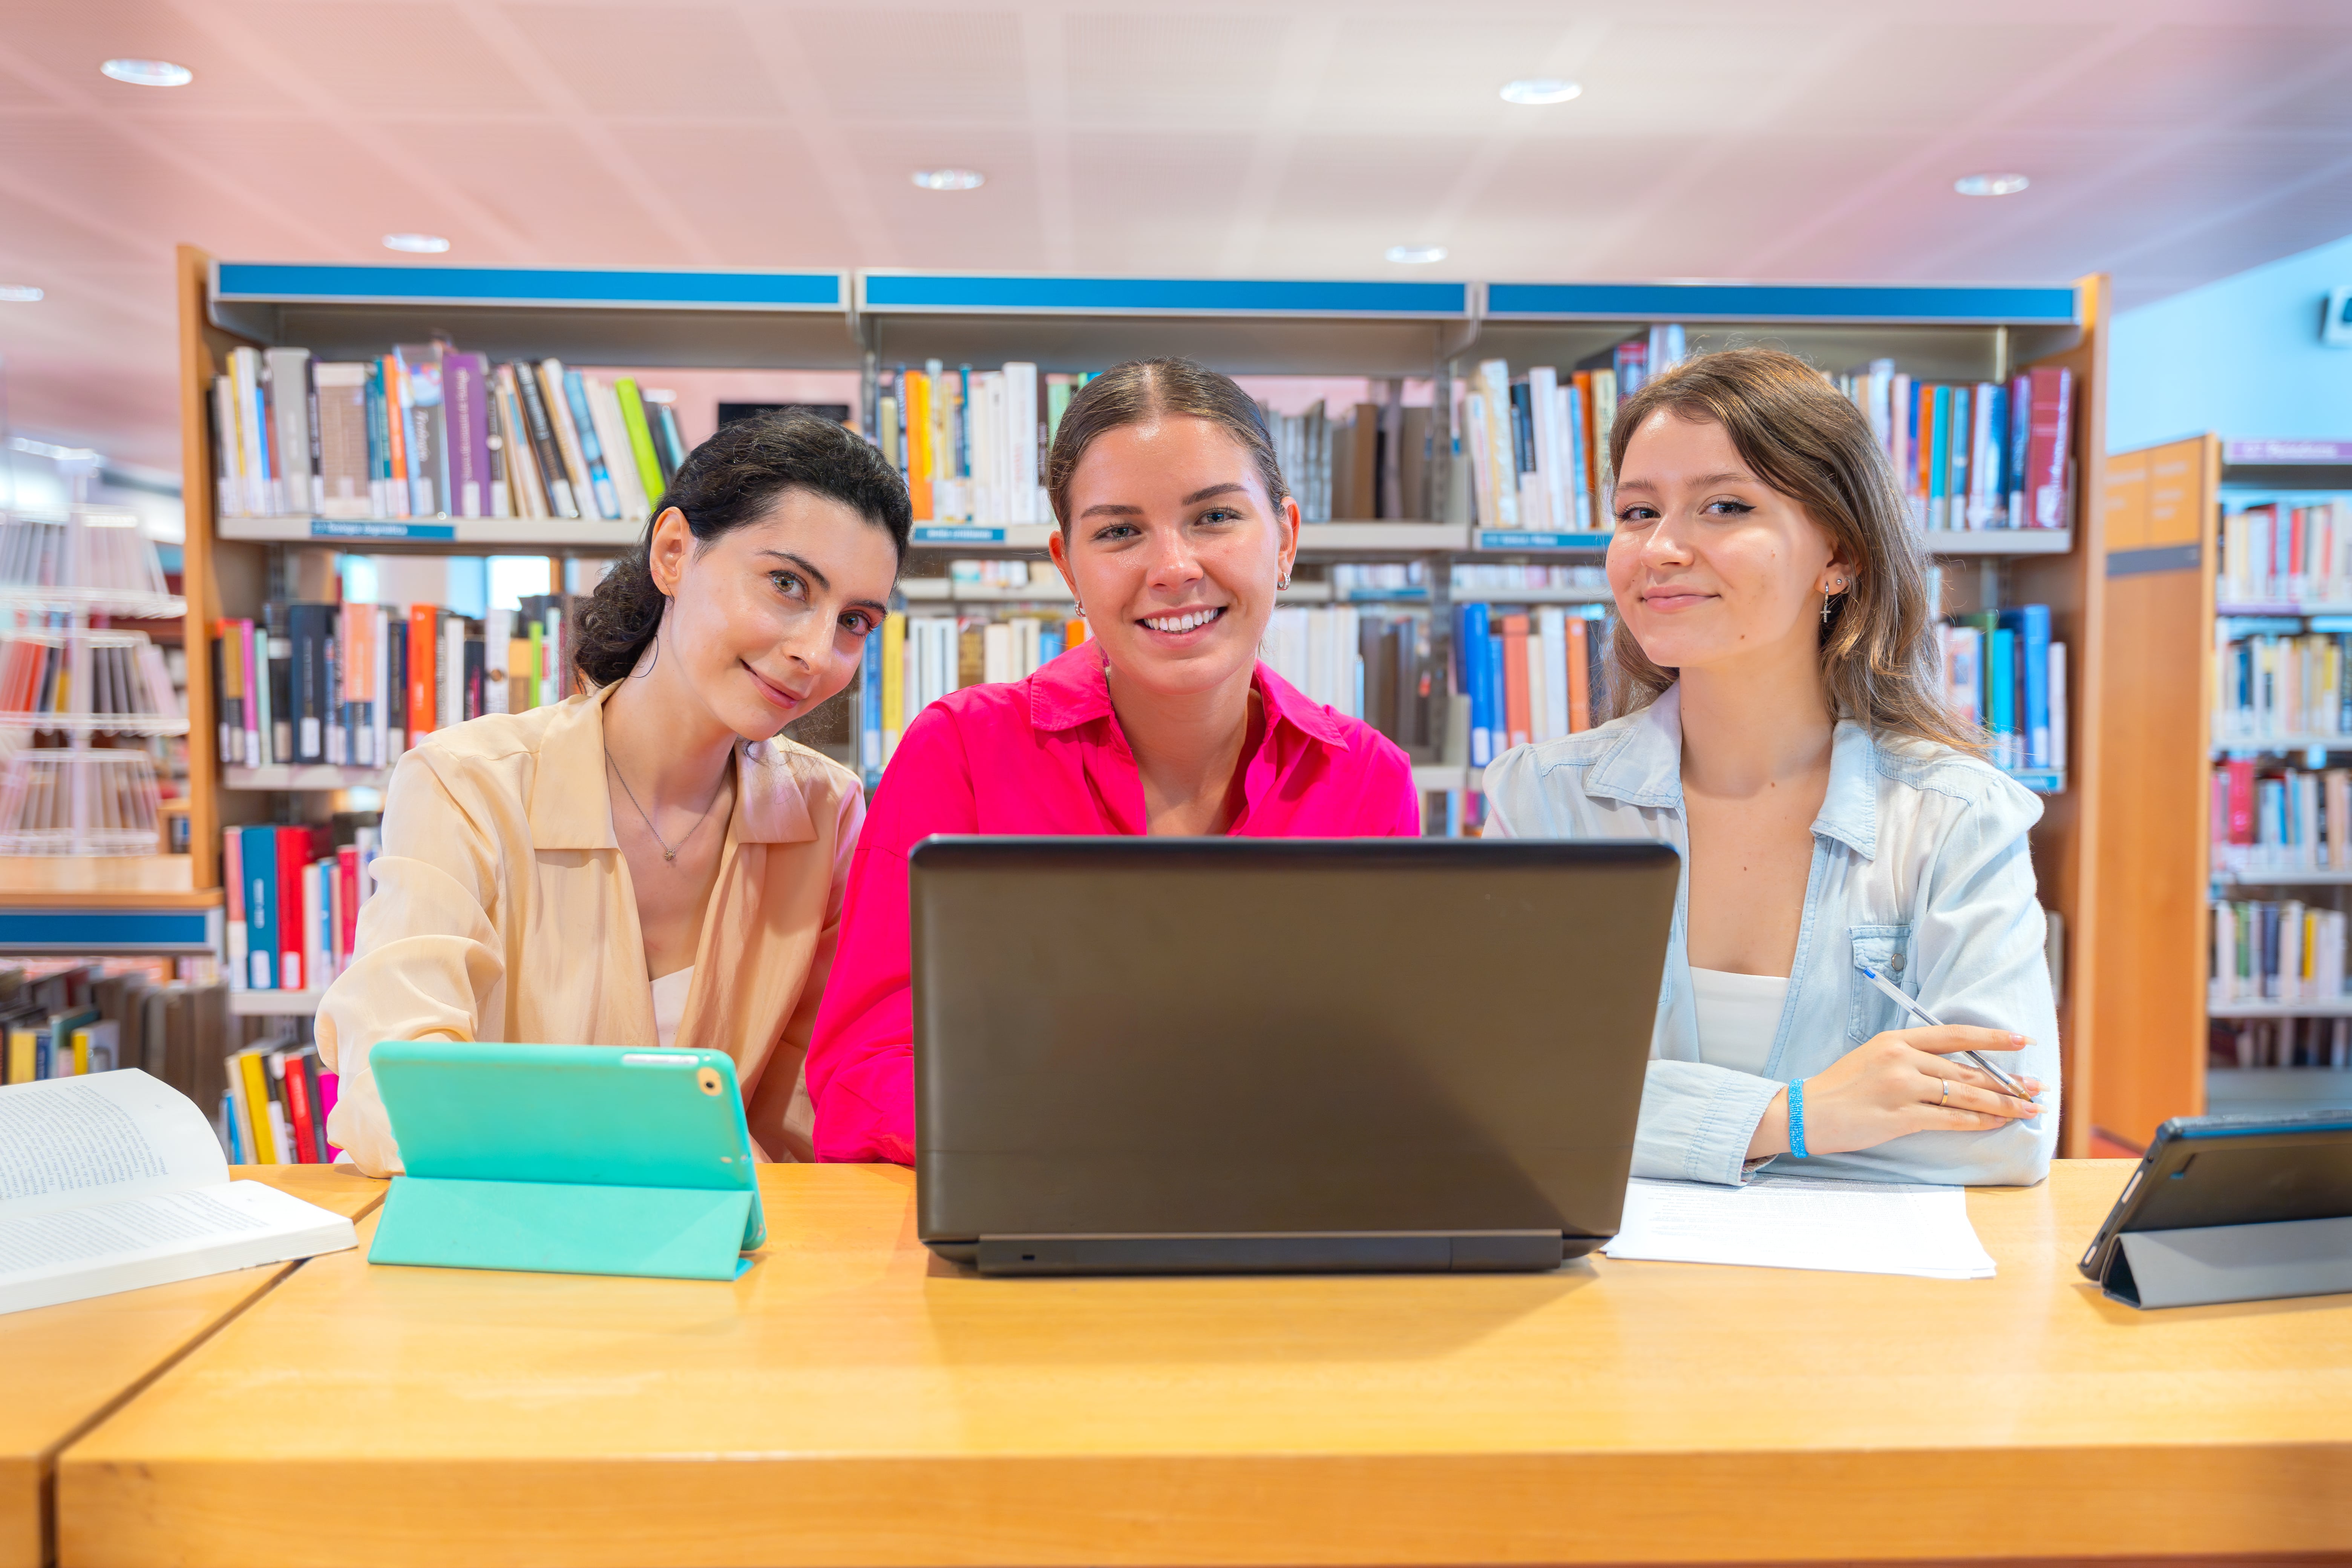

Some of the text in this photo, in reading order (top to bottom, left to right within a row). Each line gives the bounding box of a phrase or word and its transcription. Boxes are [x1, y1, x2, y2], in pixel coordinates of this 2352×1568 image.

[89, 1127, 99, 1140] comboi
[129, 1121, 141, 1134] recorda
[46, 1136, 59, 1150] l'aviació
[101, 1133, 111, 1144] indret
[113, 1137, 122, 1149] morts
[117, 1130, 128, 1143] malgrat
[129, 1135, 139, 1148] huracà
[72, 1143, 82, 1160] víctimes
[88, 1139, 97, 1153] Balmes
[109, 1145, 118, 1160] cèntric
[25, 1145, 39, 1167] homenatge
[67, 1152, 76, 1162] prop
[120, 1150, 128, 1162] molts
[127, 1145, 139, 1168] tanmateix,
[43, 1162, 54, 1175] passat
[61, 1157, 70, 1175] massius
[114, 1161, 125, 1181] d'aquell
[148, 1152, 158, 1176] l'escultura
[159, 1157, 168, 1174] plàtans.
[90, 1168, 101, 1185] perquè
[108, 1163, 116, 1183] bombes
[19, 1169, 29, 1195] Tarragona,
[28, 1168, 39, 1194] República,
[48, 1177, 55, 1185] Ha
[57, 1173, 66, 1191] esperar
